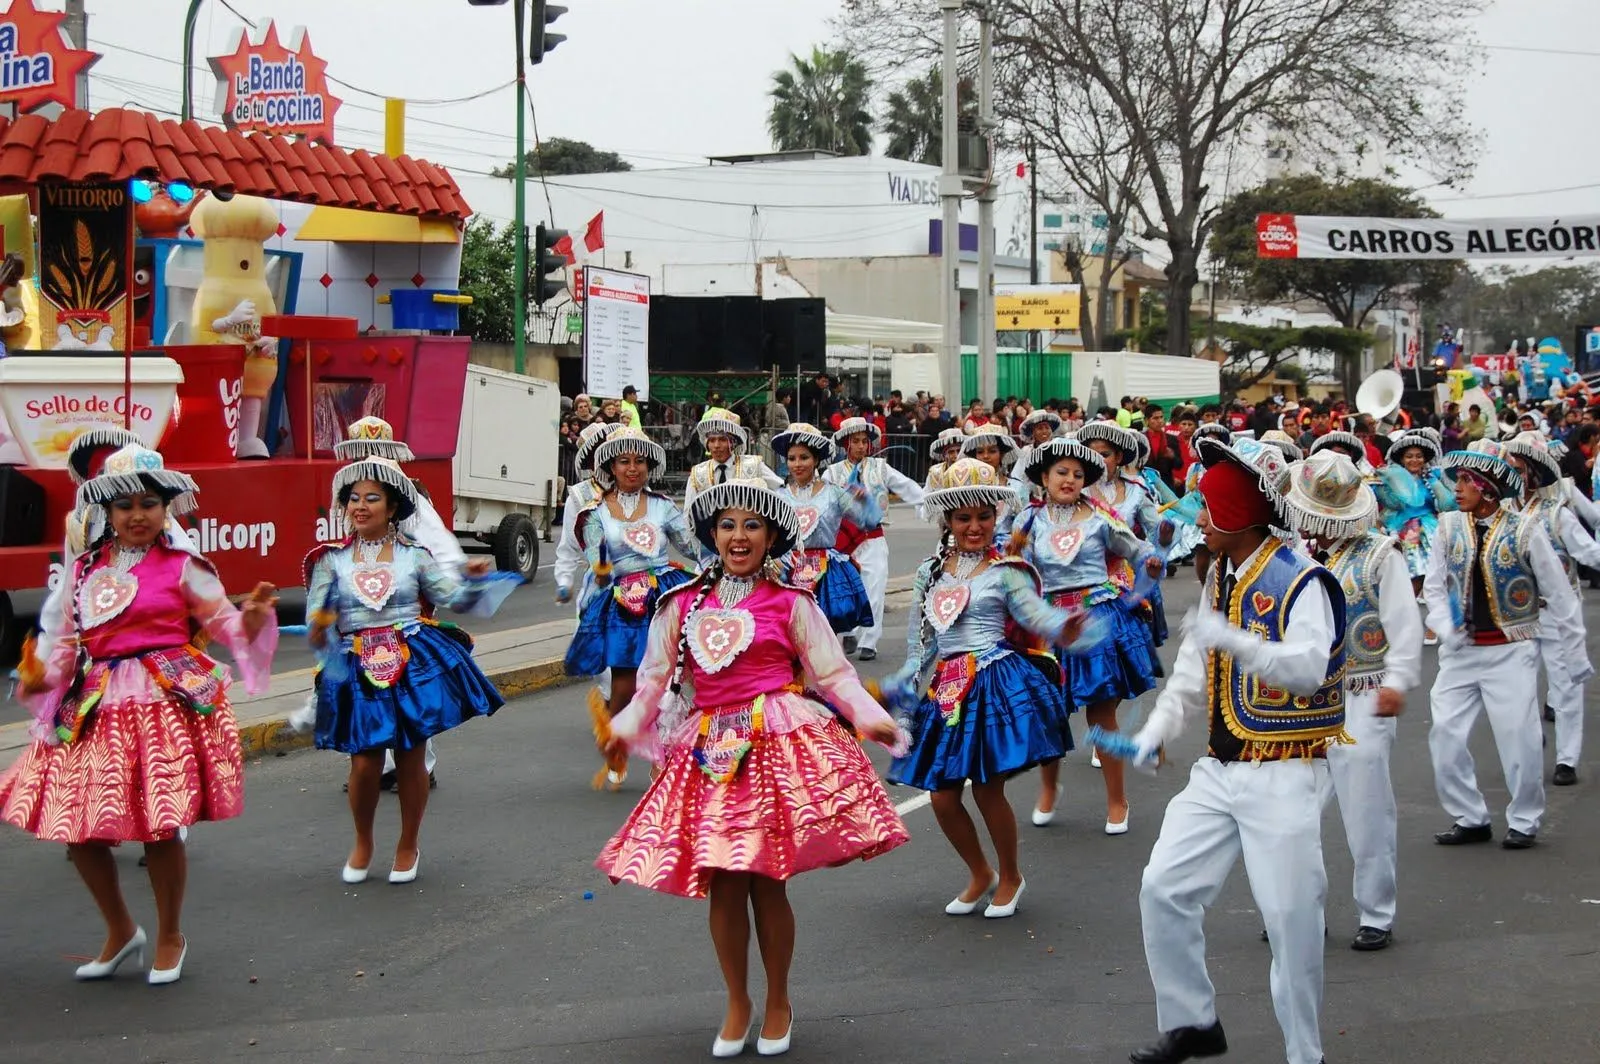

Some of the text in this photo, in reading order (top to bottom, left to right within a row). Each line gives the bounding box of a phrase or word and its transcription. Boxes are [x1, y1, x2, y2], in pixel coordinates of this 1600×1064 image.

[236, 57, 304, 95] La Banda
[236, 91, 321, 123] de tu cocina
[45, 183, 124, 212] VITTORIO
[888, 171, 940, 207] VIADES
[1260, 231, 1295, 242] CORSO
[1327, 229, 1454, 254] CARROS
[1021, 297, 1050, 306] BAÑOS
[26, 395, 80, 418] Sello
[85, 395, 109, 412] de
[114, 396, 153, 421] Oro
[187, 518, 276, 556] alicorp
